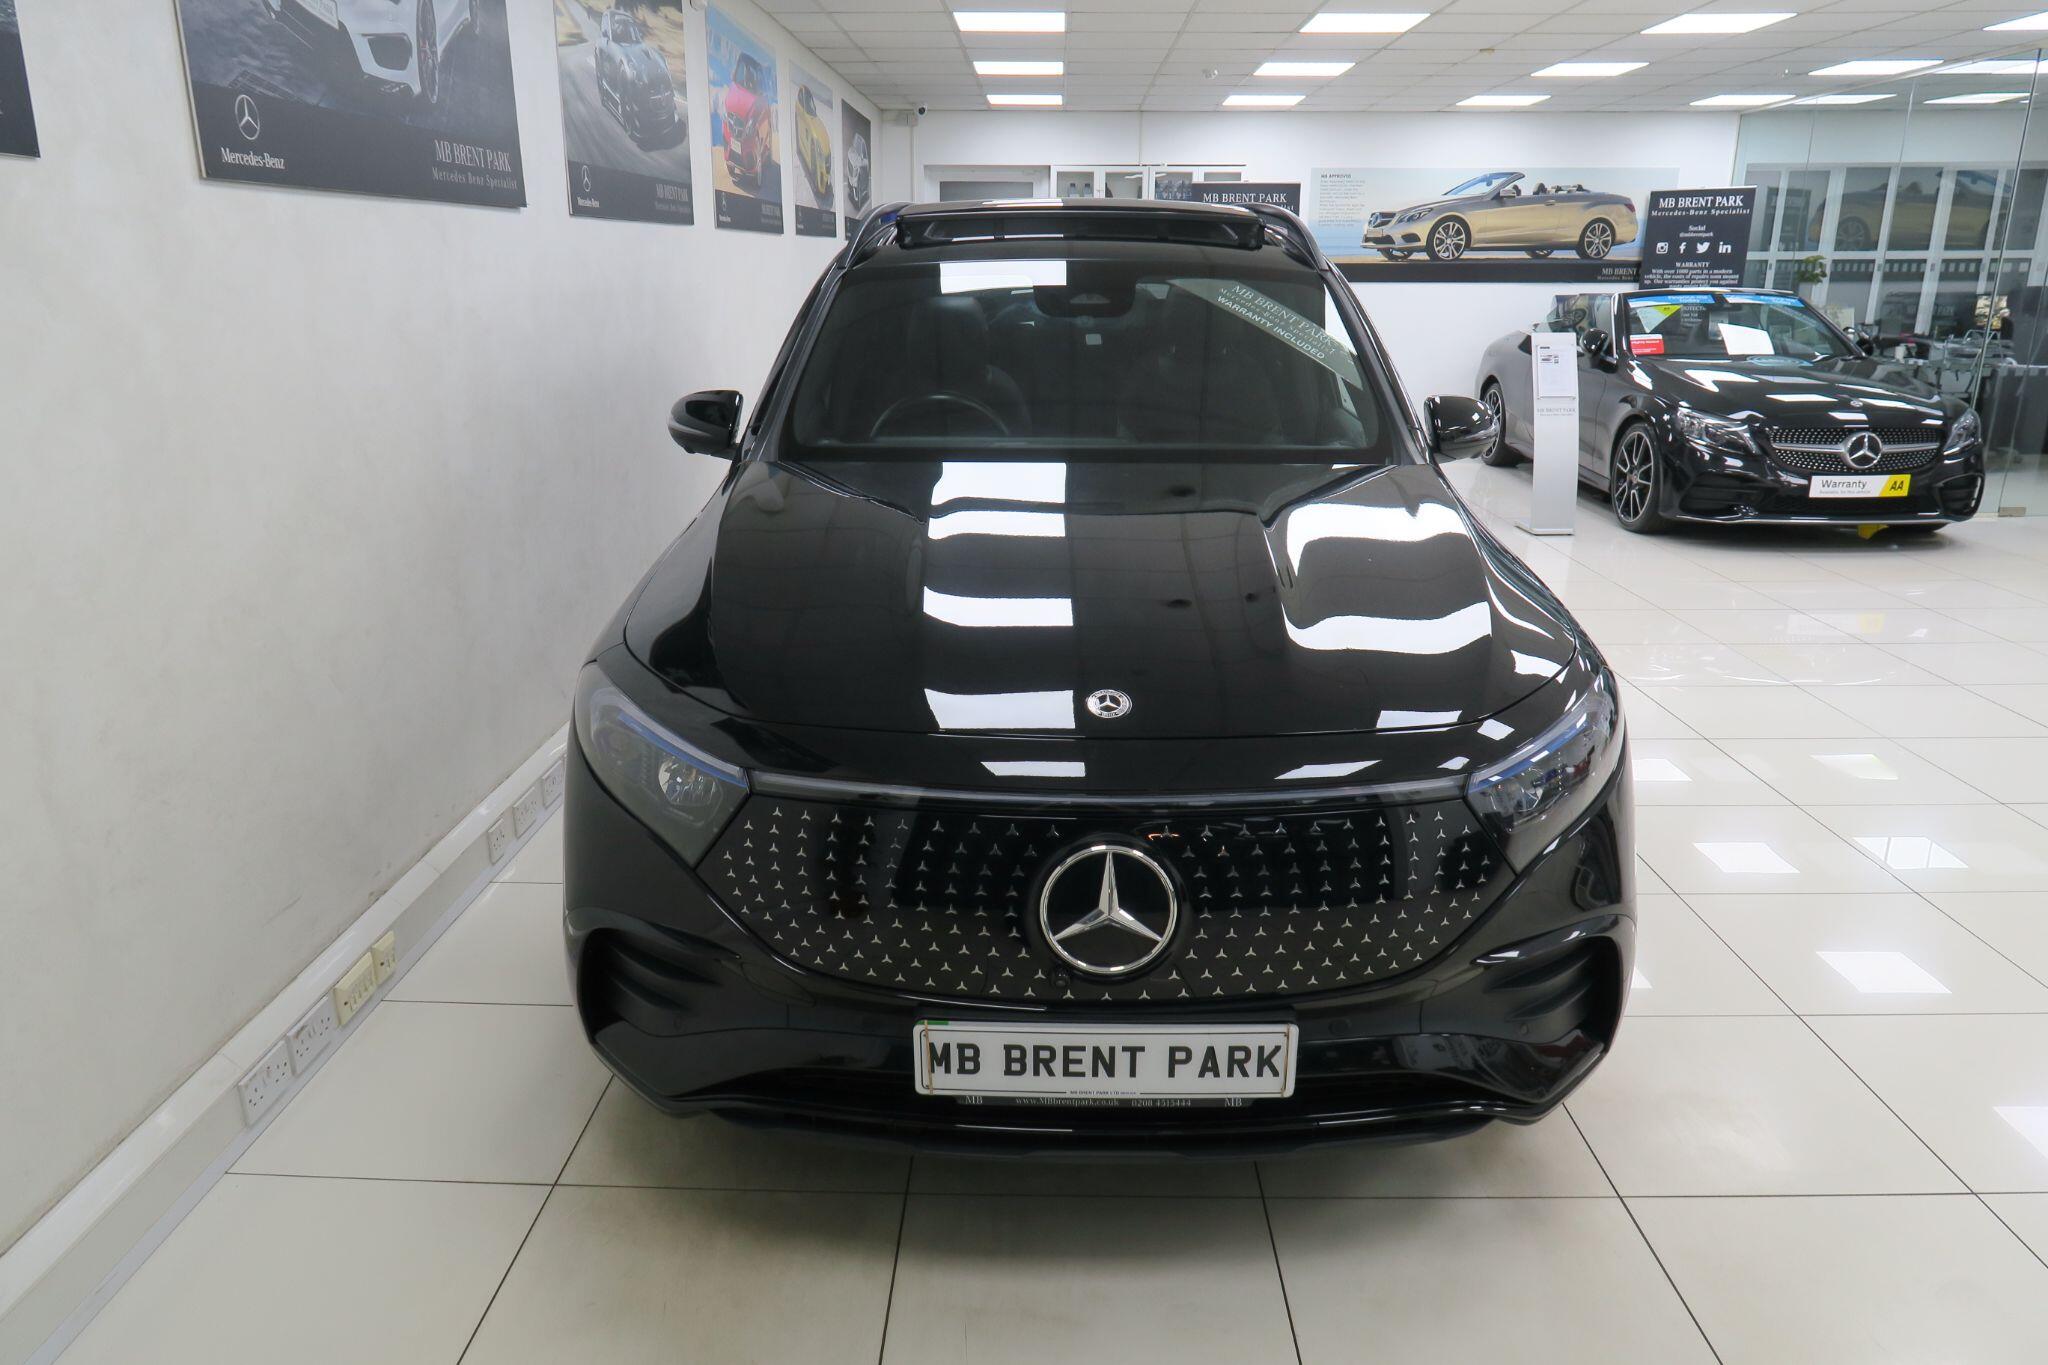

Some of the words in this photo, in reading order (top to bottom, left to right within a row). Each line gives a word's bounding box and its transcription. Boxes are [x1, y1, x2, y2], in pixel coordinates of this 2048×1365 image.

[221, 147, 285, 169] Mercedes-Benz
[434, 139, 452, 163] MB
[453, 143, 485, 168] BRENT
[486, 149, 512, 172] PARK
[1203, 193, 1219, 203] MB
[1222, 193, 1256, 203] BRENT
[1259, 193, 1288, 203] PARK
[1659, 197, 1676, 209] MB
[1678, 196, 1714, 208] BRENT
[1715, 195, 1744, 207] PARK
[1651, 209, 1708, 217] Mercedes-Benz
[1711, 208, 1750, 217] Specialist
[1614, 267, 1637, 275] BRENT
[1232, 285, 1254, 300] MB
[1255, 296, 1298, 324] BRENT
[1298, 321, 1333, 346] PARK
[1217, 295, 1274, 327] WARRANTY
[1273, 326, 1326, 360] INCLUDED
[1821, 480, 1867, 490] Warranty
[1889, 481, 1904, 492] AA
[929, 1042, 981, 1076] MB
[1003, 1043, 1146, 1079] BRENT
[1168, 1044, 1283, 1079] PARK
[965, 1095, 983, 1105] MB
[1225, 1097, 1242, 1107] MB
